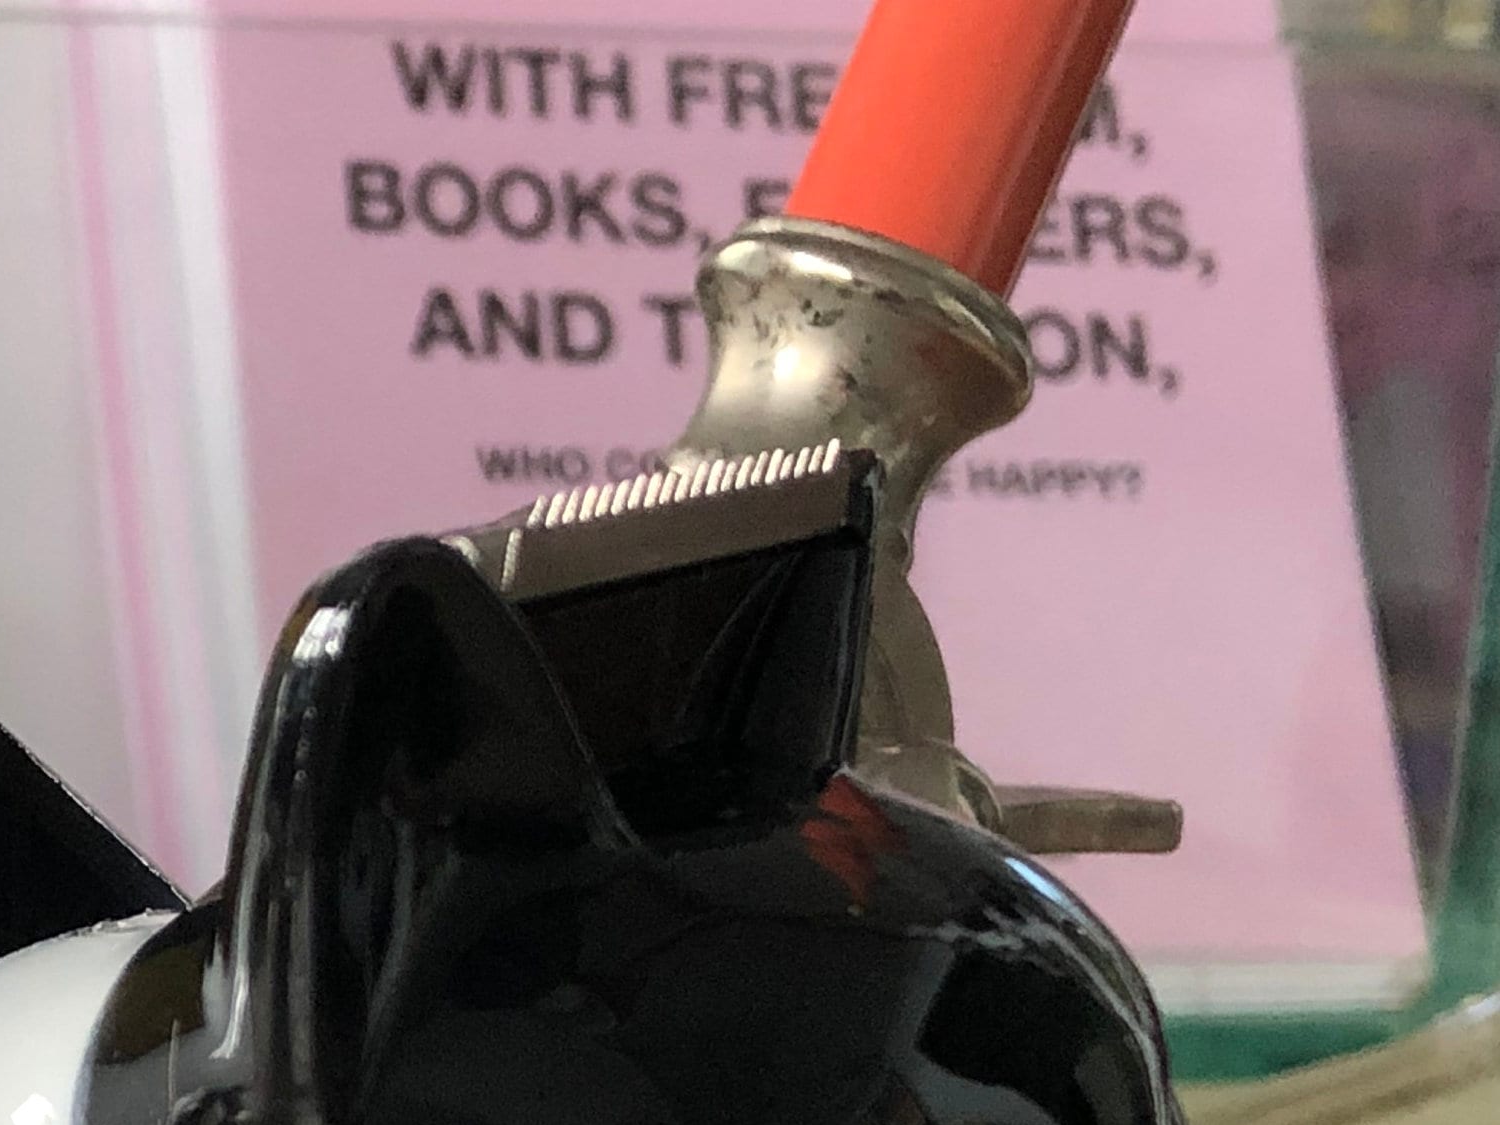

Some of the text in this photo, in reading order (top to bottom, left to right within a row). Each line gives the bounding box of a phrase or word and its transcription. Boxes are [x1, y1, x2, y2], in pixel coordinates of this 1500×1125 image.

[392, 40, 635, 125] WITH
[345, 159, 711, 252] BOOKS,
[411, 287, 613, 364] AND
[476, 444, 591, 484] WHO
